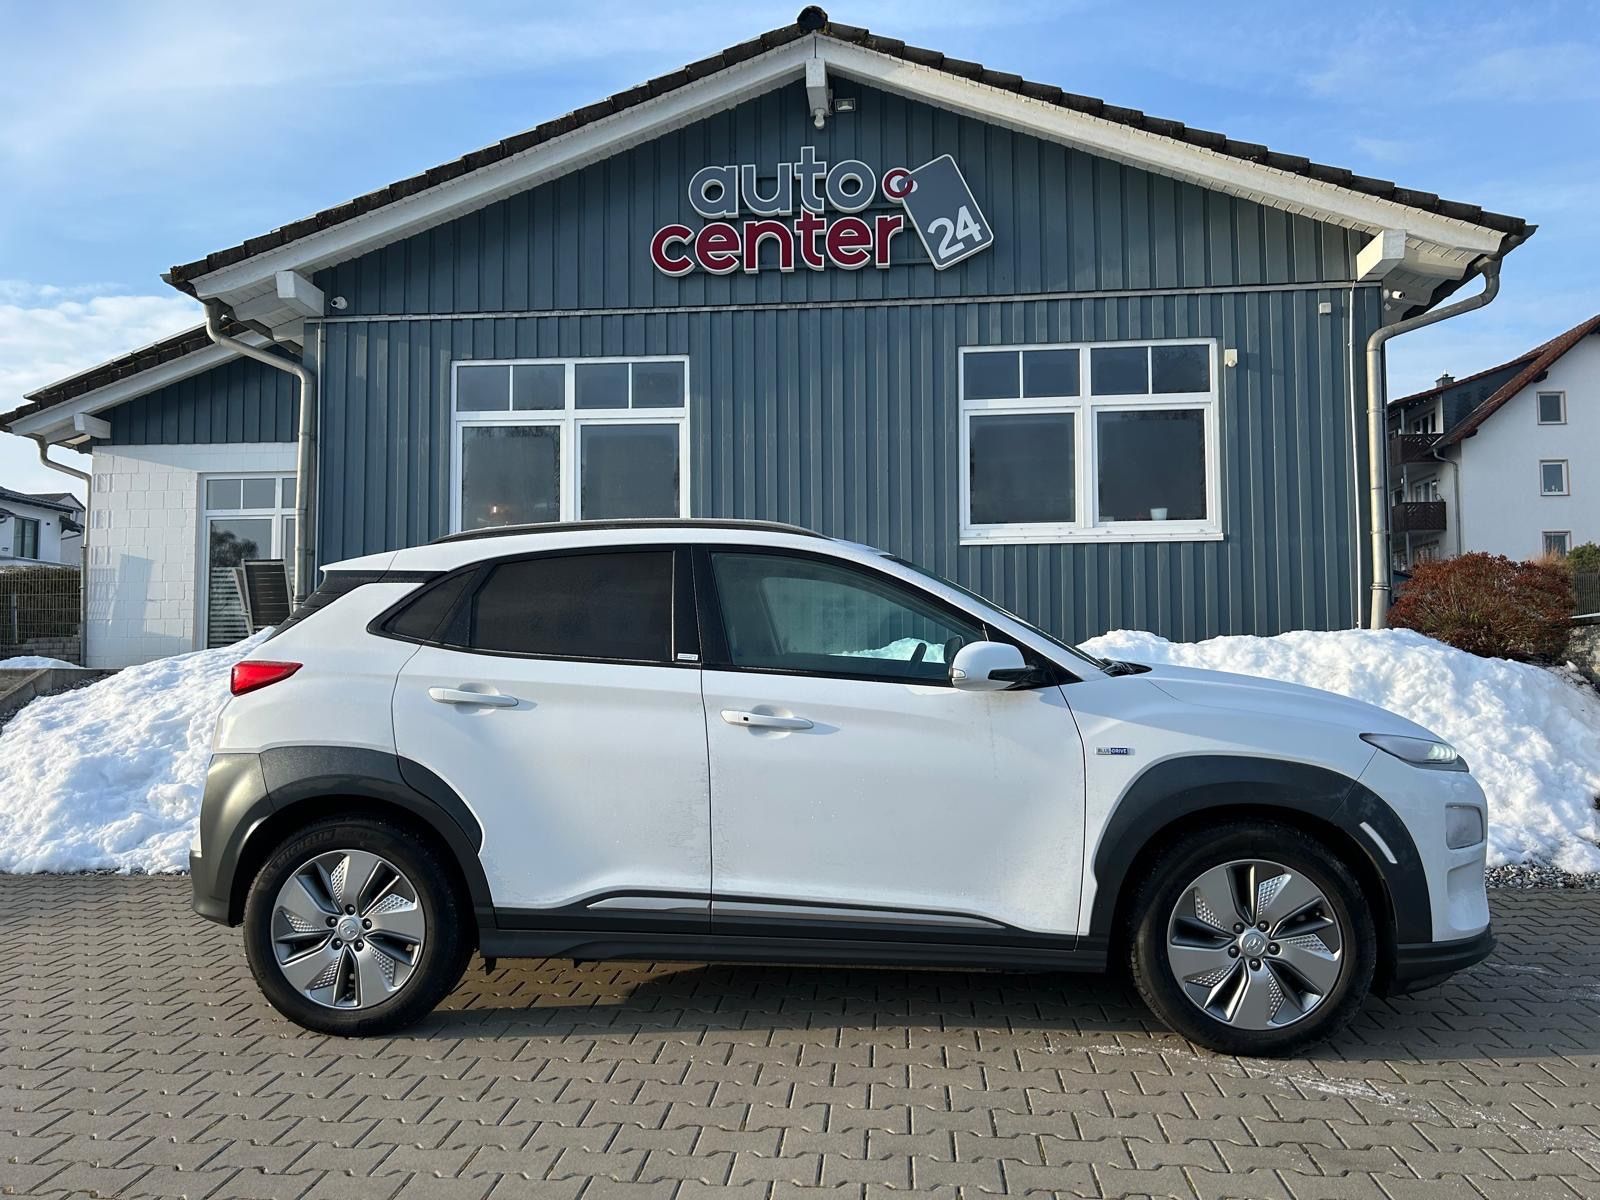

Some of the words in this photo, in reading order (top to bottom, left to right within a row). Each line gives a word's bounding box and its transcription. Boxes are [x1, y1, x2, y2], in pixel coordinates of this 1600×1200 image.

[688, 146, 876, 218] auto
[651, 205, 904, 277] center
[927, 205, 982, 260] 24
